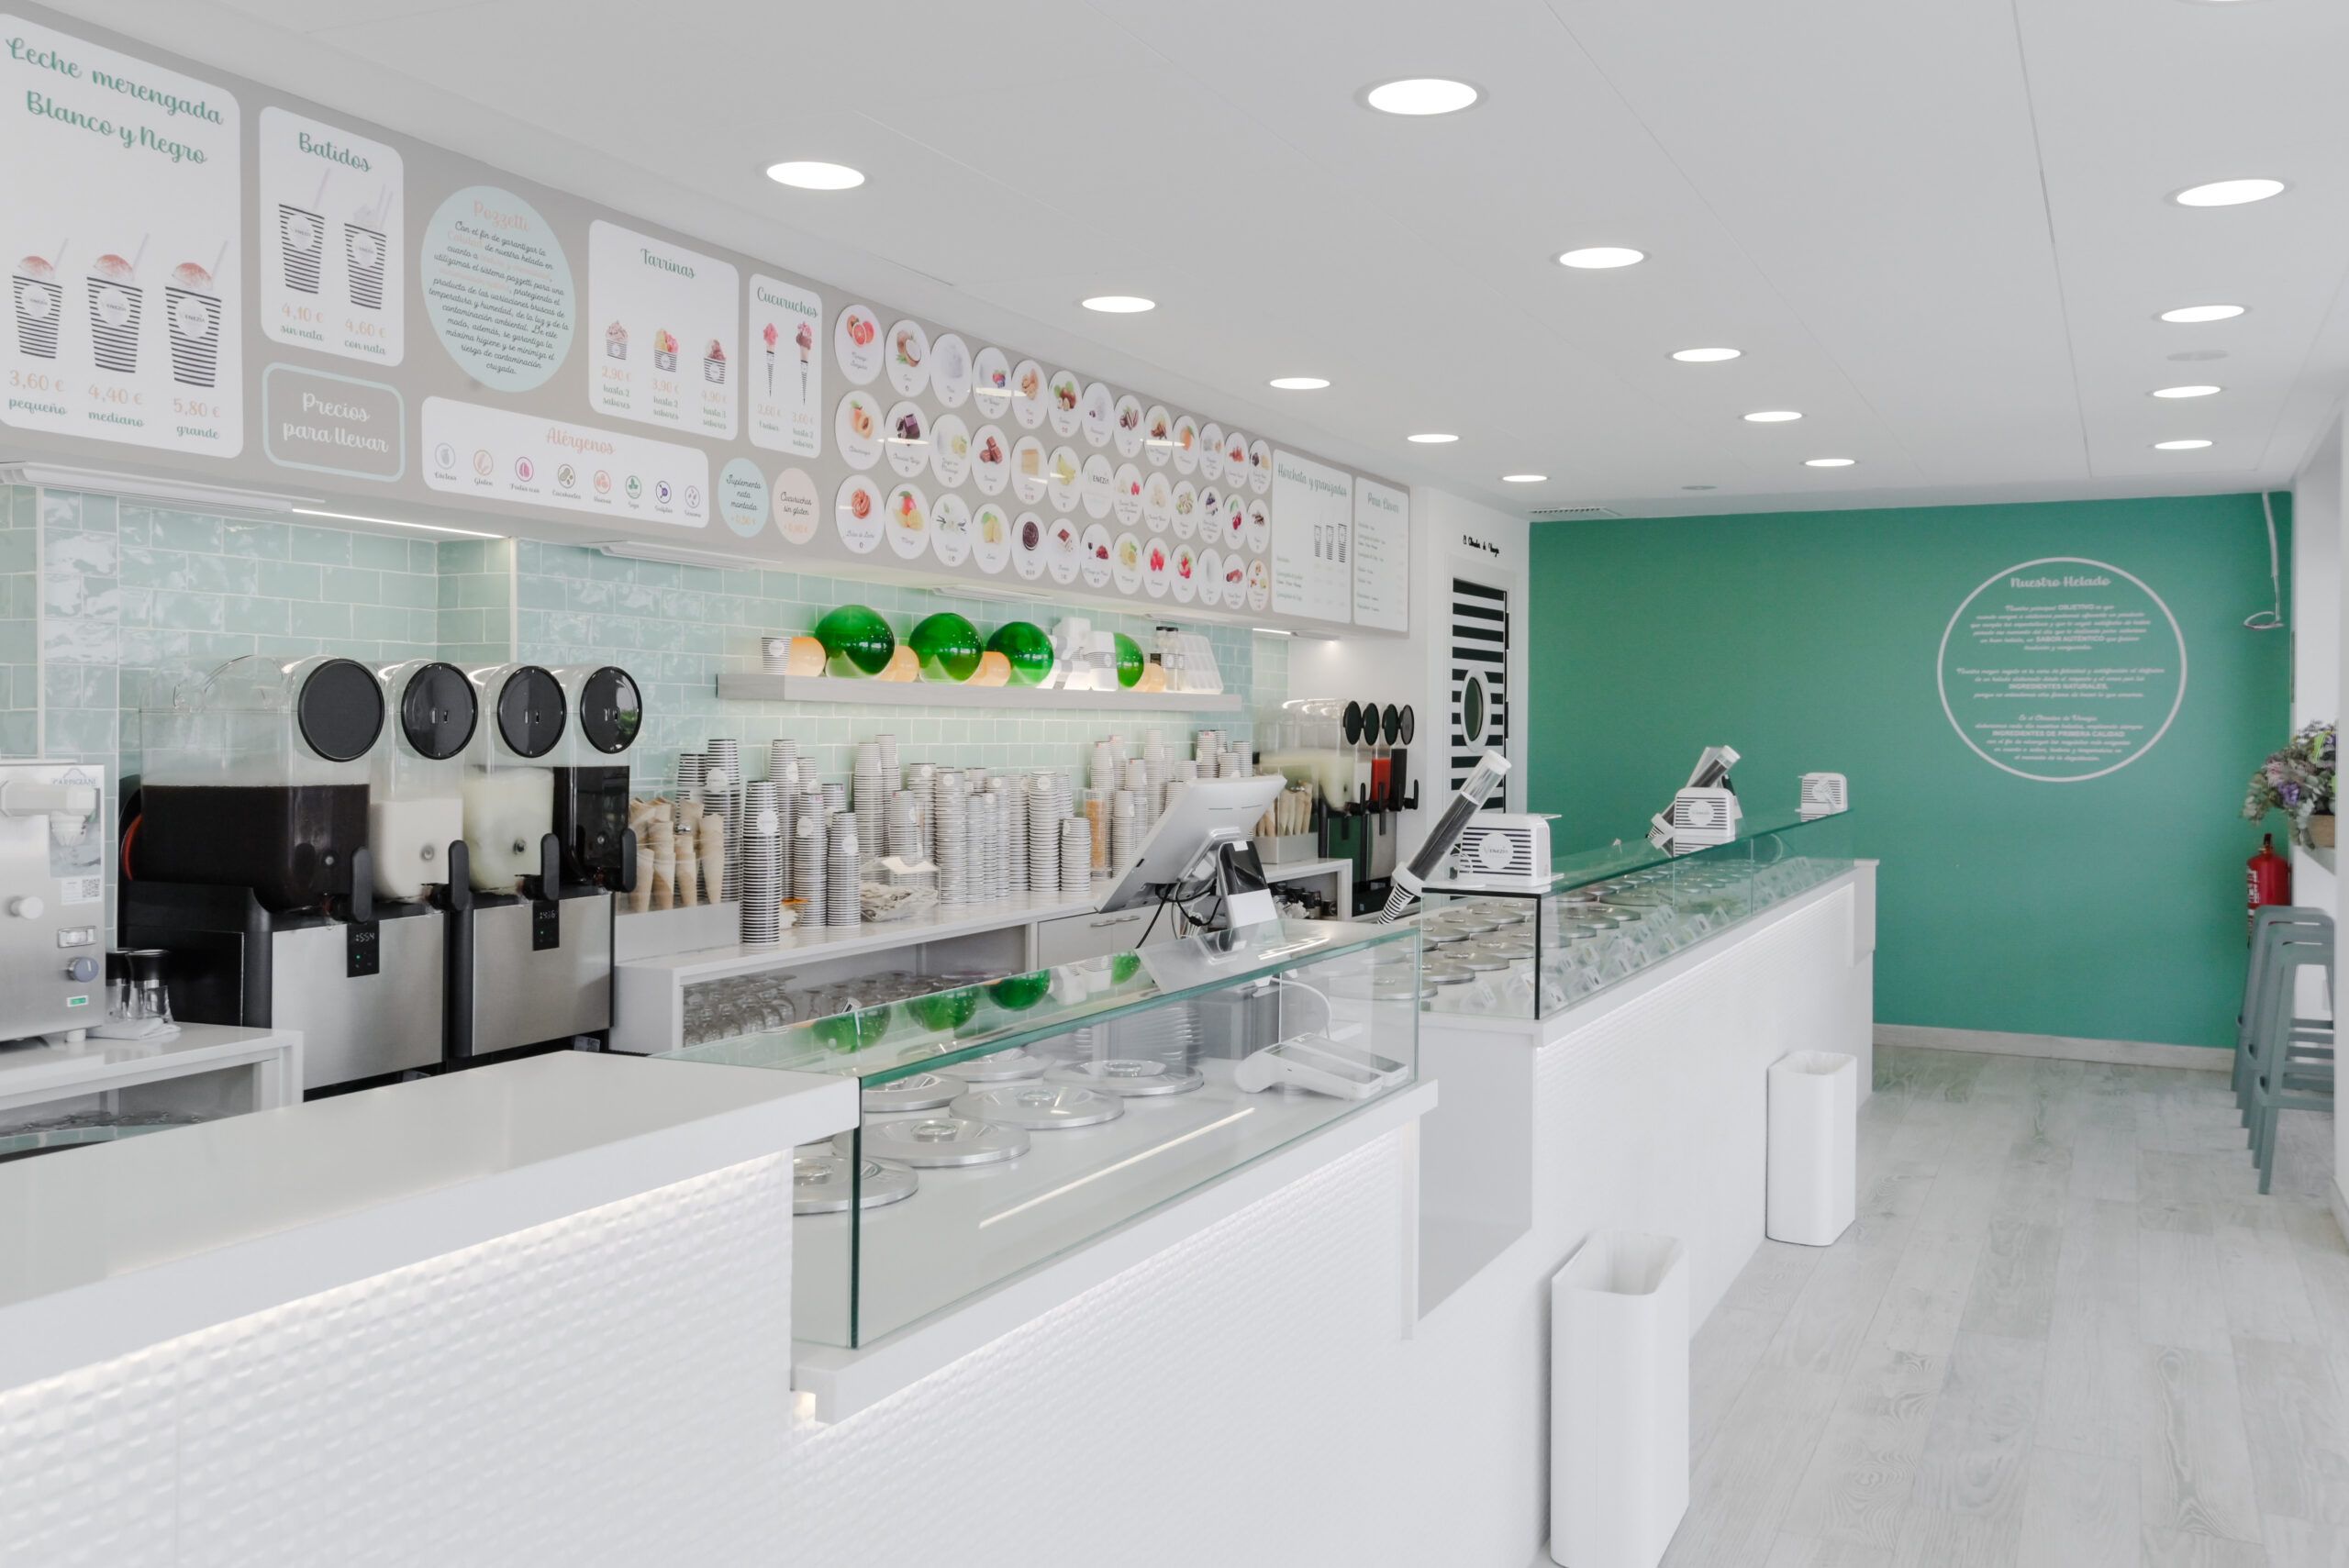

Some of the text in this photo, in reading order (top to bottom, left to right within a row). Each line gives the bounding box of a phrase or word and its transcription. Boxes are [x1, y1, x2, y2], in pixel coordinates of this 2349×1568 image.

[6, 38, 224, 125] Leche merengada
[27, 90, 208, 164] Blanco y Negro
[298, 131, 373, 172] Batidos
[454, 220, 547, 257] Con el fin de garantizar la
[484, 243, 494, 252] de
[495, 248, 520, 260] nuestro
[521, 253, 544, 267] helado
[640, 248, 696, 279] Tarrinas
[429, 287, 472, 306] temperatura
[433, 277, 466, 292] producto
[467, 286, 477, 295] de
[756, 285, 818, 318] Cucuruchos
[281, 302, 324, 323] 4,10 €
[280, 325, 325, 342] sin nata
[344, 318, 388, 339] 4,60 €
[344, 339, 386, 355] con nata
[9, 370, 65, 392] 3,60 €
[603, 384, 624, 396] hasta
[88, 383, 143, 406] 4,40 €
[602, 396, 631, 410] sabores
[653, 395, 673, 406] hasta
[8, 398, 67, 416] pequeño
[173, 397, 220, 418] 5,80 €
[302, 392, 371, 422] Precios
[88, 411, 145, 428] mediano
[176, 425, 219, 439] grande
[283, 422, 389, 453] para llevar
[545, 426, 617, 456] Alérgenos
[2010, 575, 2110, 588] Nuestro Helado
